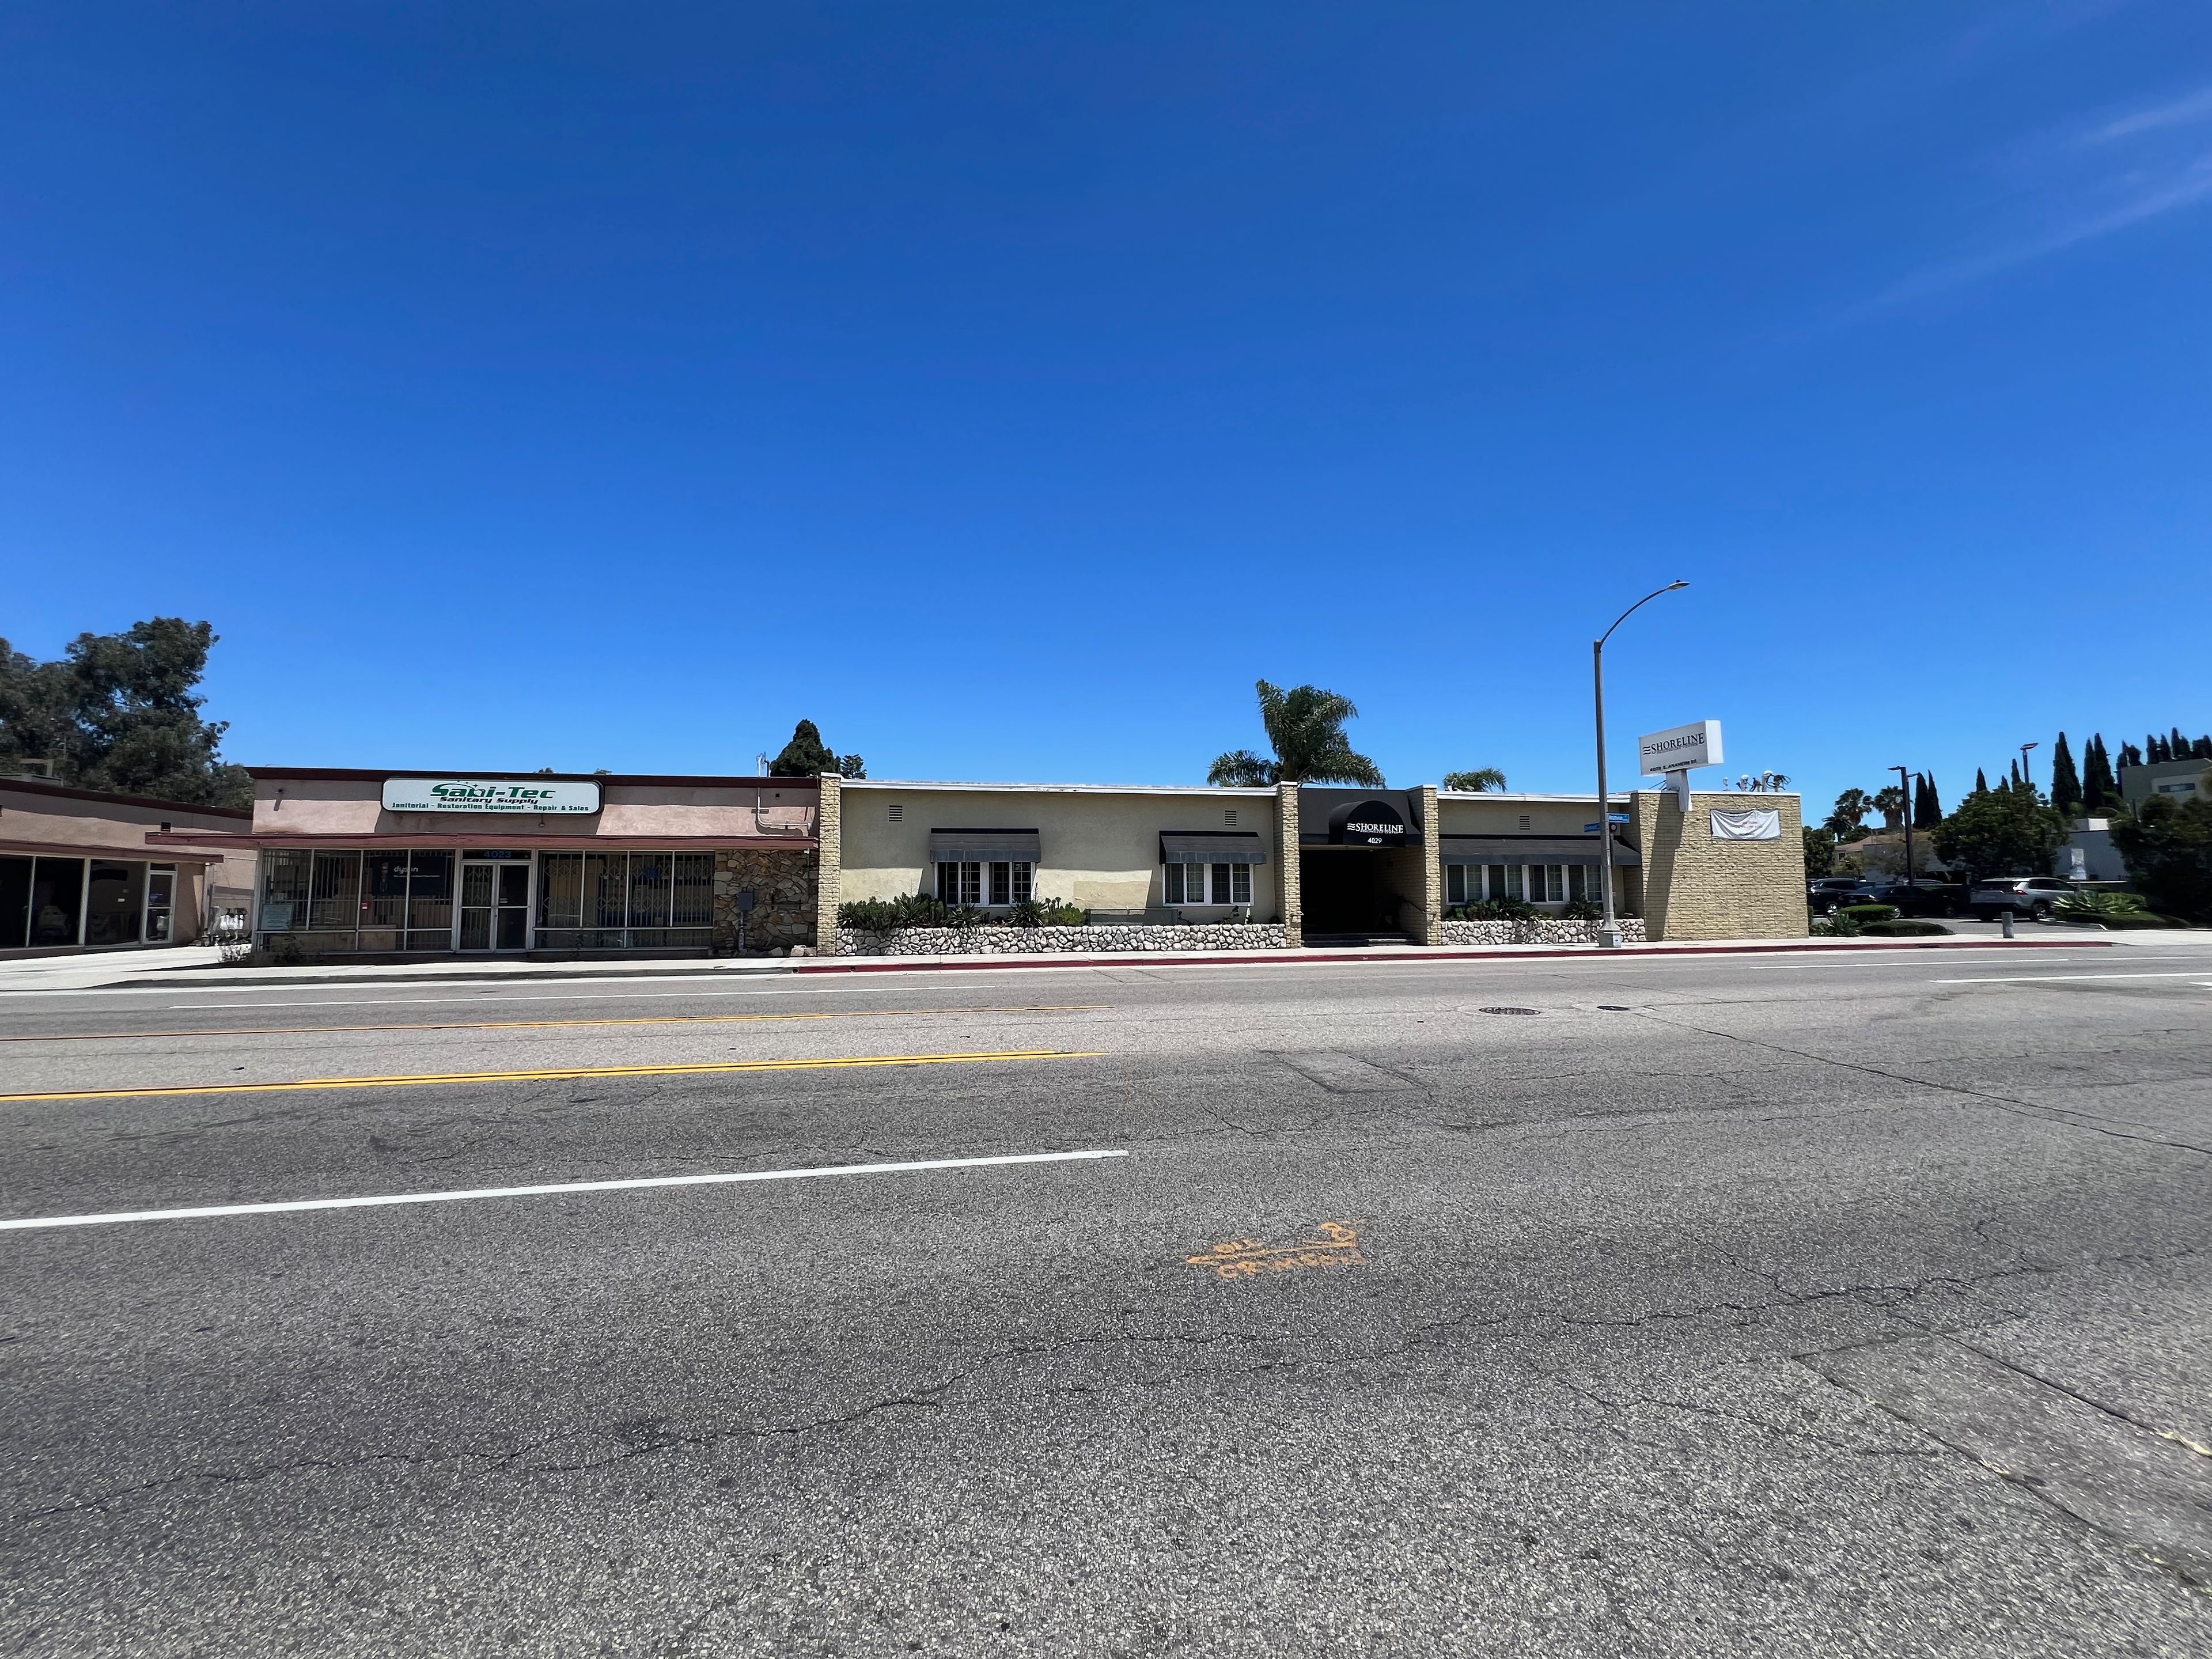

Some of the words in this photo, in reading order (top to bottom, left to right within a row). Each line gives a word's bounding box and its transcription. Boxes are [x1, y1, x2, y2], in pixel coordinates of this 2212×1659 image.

[1651, 733, 1705, 754] SHORELINE
[430, 783, 556, 798] Sani-Tec
[1355, 823, 1404, 834] SHORELINE
